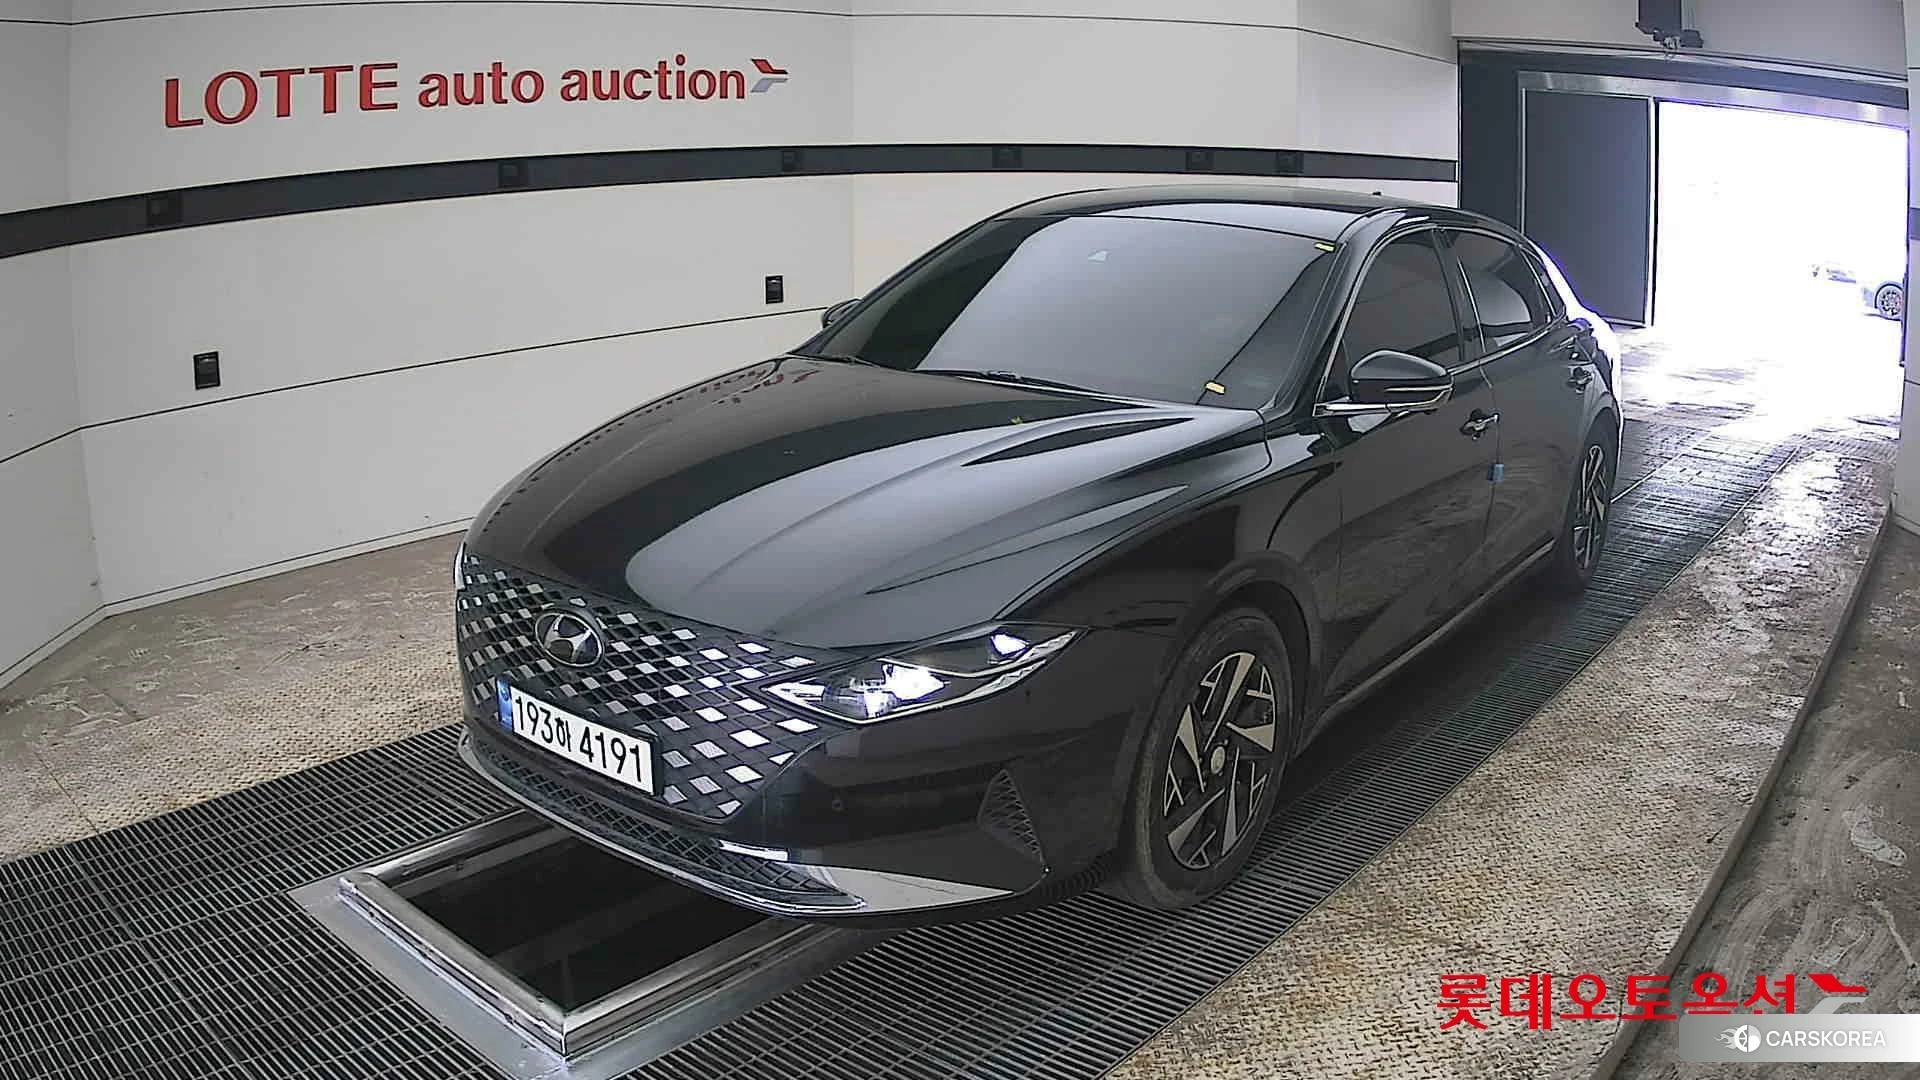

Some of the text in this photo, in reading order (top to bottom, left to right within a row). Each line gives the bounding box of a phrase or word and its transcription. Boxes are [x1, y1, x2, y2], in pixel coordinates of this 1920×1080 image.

[164, 53, 746, 128] LOTTE auto auction
[515, 695, 642, 783] 193하 4191
